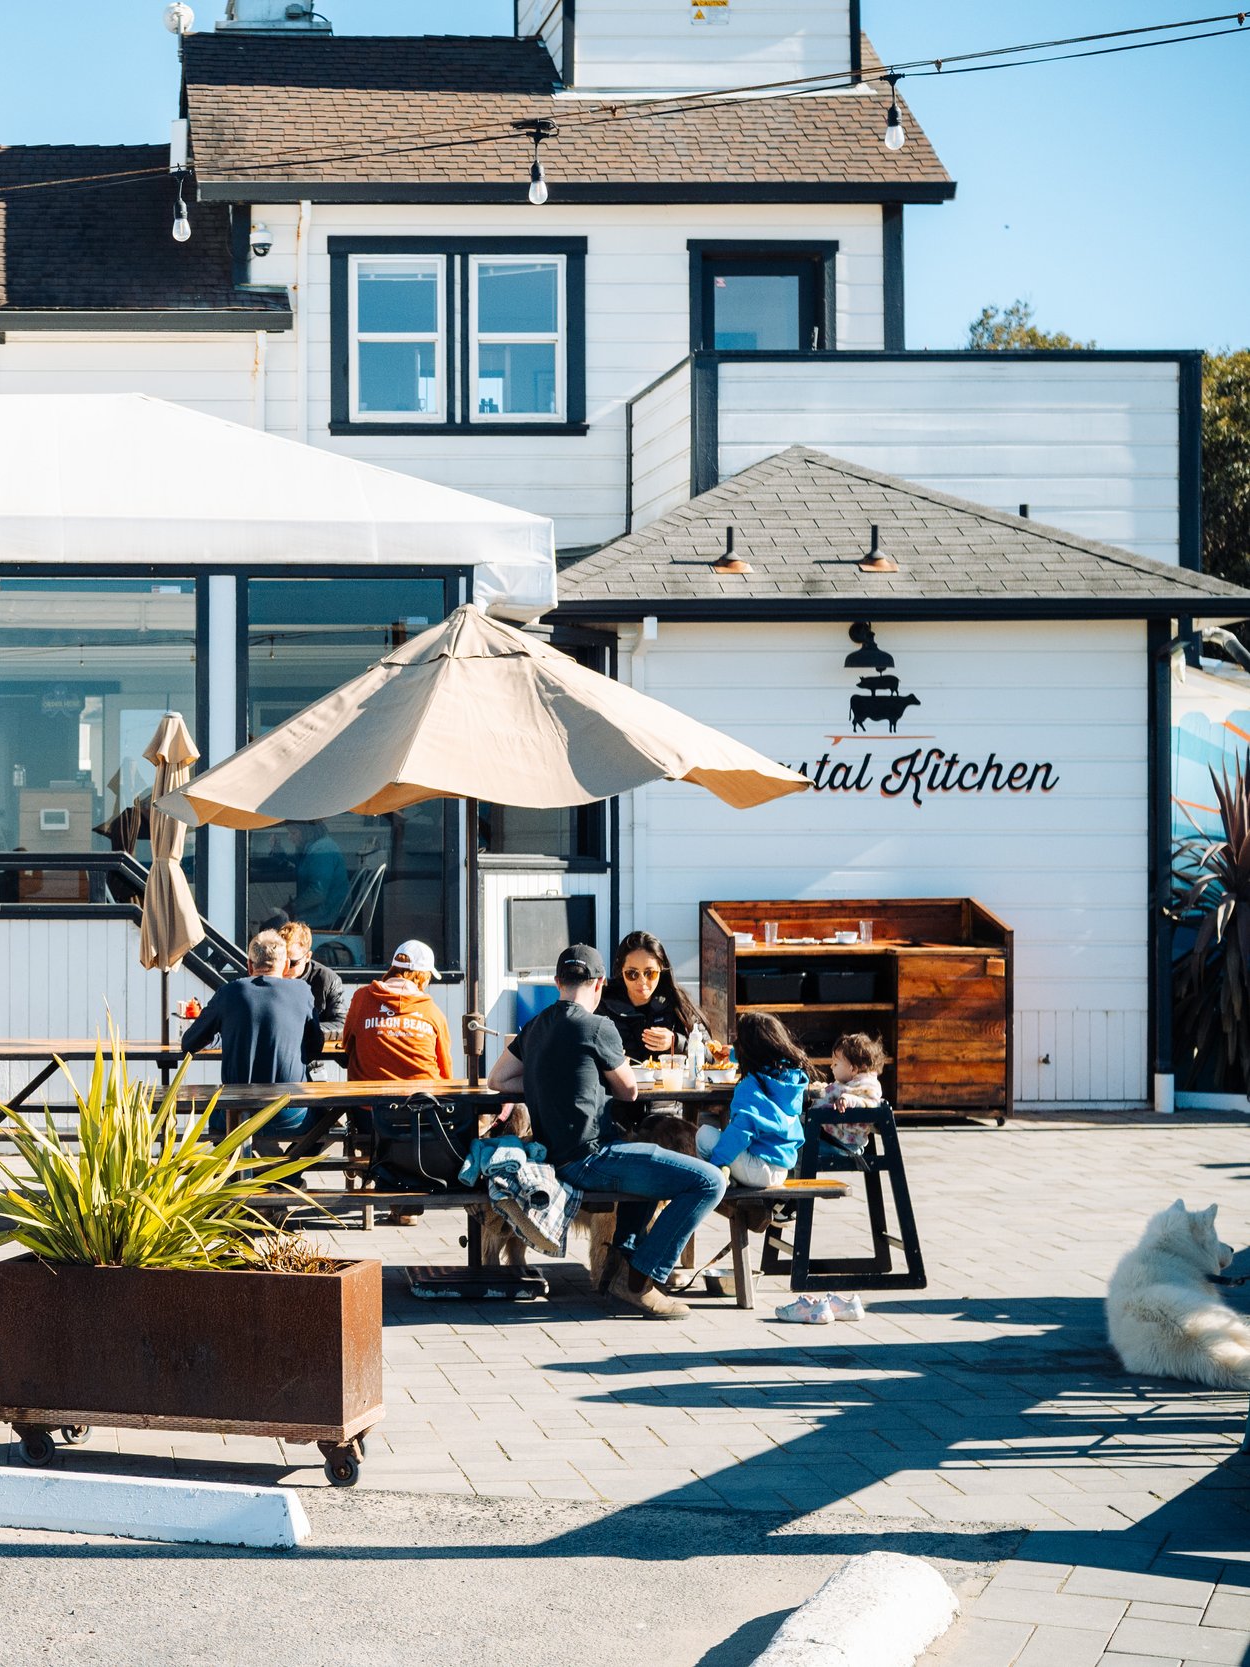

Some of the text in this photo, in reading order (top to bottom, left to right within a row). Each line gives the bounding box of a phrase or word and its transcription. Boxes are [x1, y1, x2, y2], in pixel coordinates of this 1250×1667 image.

[778, 748, 1060, 807] stal Kitchen
[365, 1017, 434, 1035] DILLON BEACH
